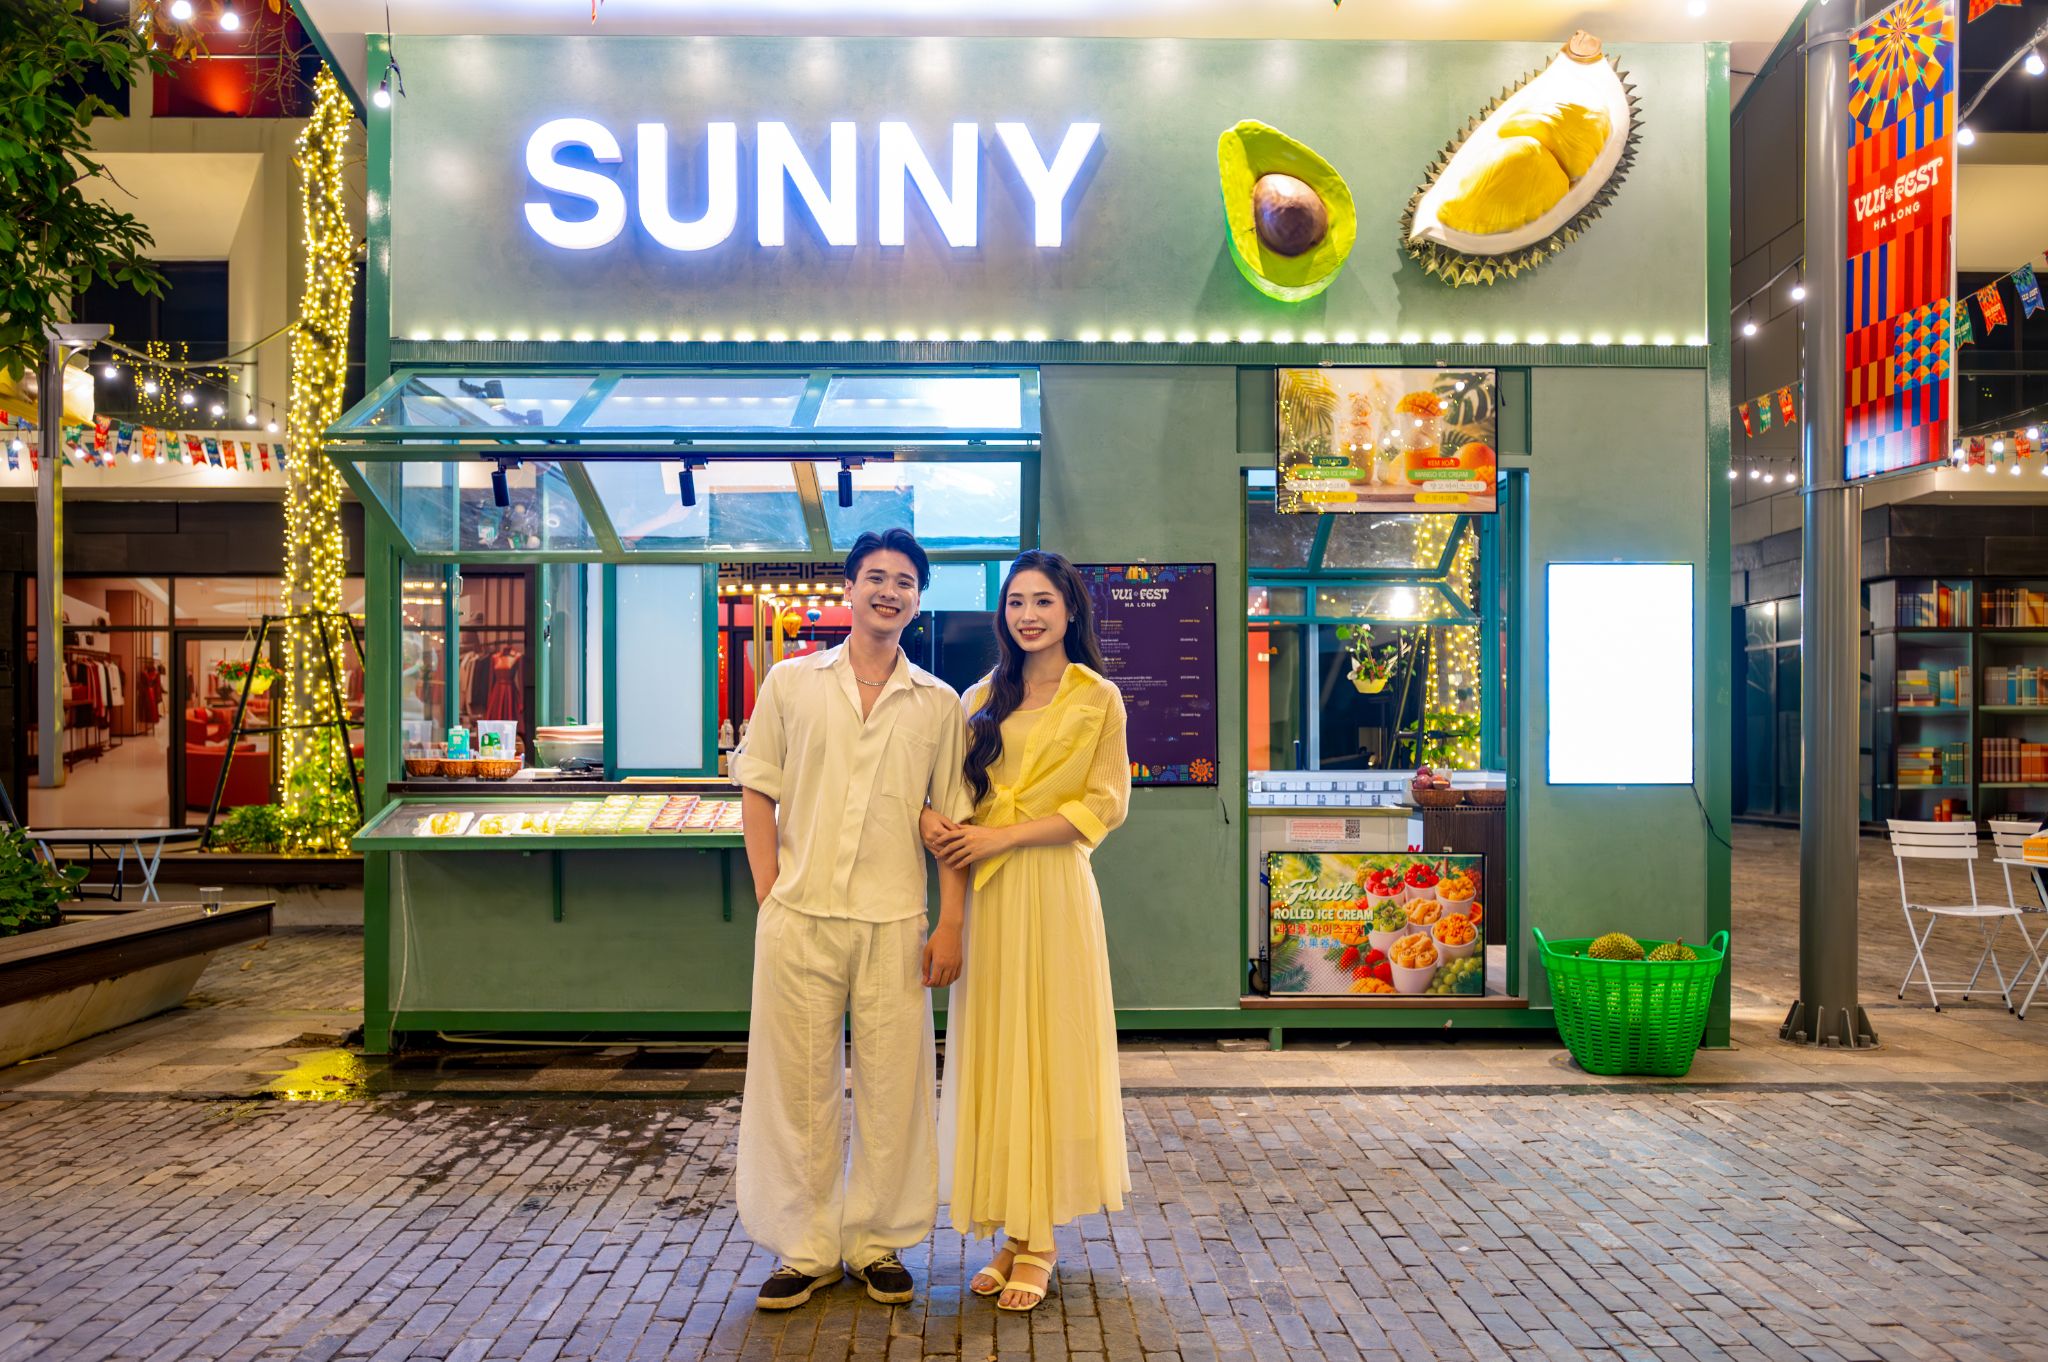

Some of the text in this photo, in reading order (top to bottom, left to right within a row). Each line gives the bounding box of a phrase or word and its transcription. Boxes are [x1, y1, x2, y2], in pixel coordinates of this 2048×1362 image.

[525, 118, 1101, 251] SUNNY
[1854, 157, 1944, 222] VUI FEST
[1873, 201, 1921, 231] HA LONG
[1112, 588, 1169, 600] VUI FEST
[1273, 907, 1375, 922] ROLLED ICE CREAM
[1311, 923, 1365, 937] 아이스크림
